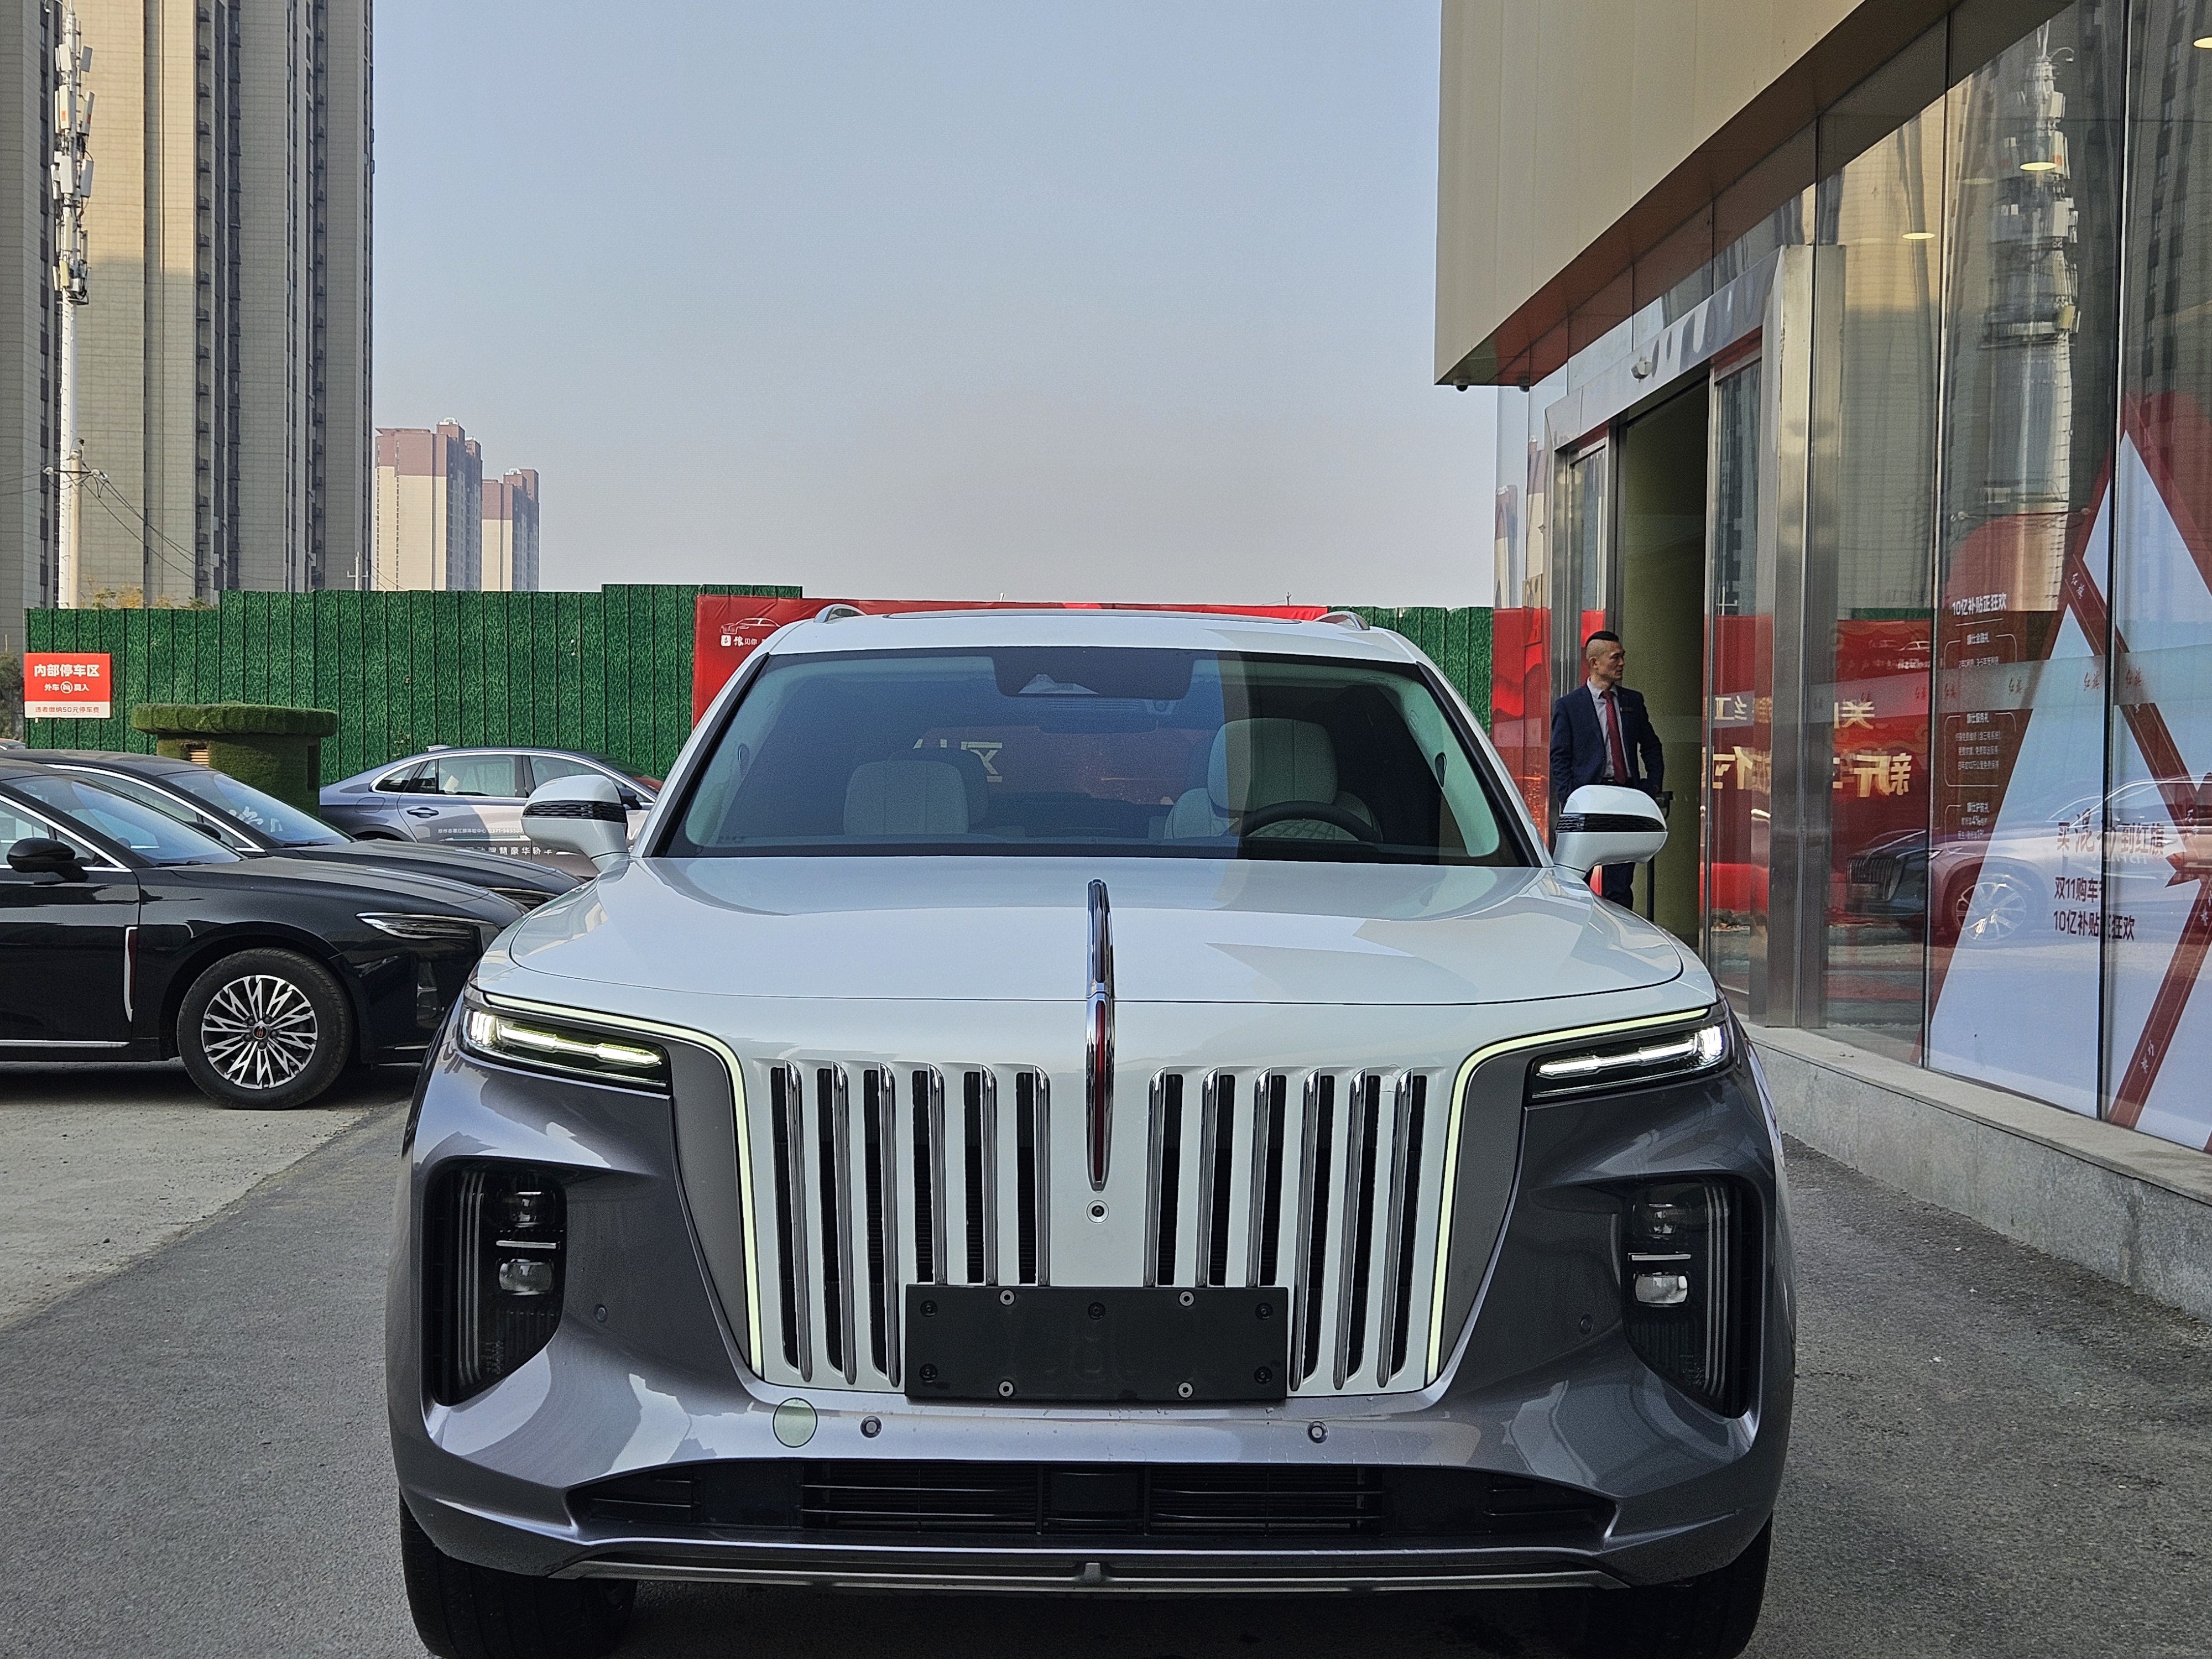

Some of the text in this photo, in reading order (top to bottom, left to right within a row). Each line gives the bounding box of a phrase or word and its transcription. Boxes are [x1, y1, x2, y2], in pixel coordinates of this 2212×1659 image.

[1952, 592, 2007, 615] 10亿补贴正狂欢
[34, 664, 100, 677] 内部停车区
[2054, 877, 2102, 903] 双11购车
[2054, 910, 2135, 941] 10亿补贴狂欢
